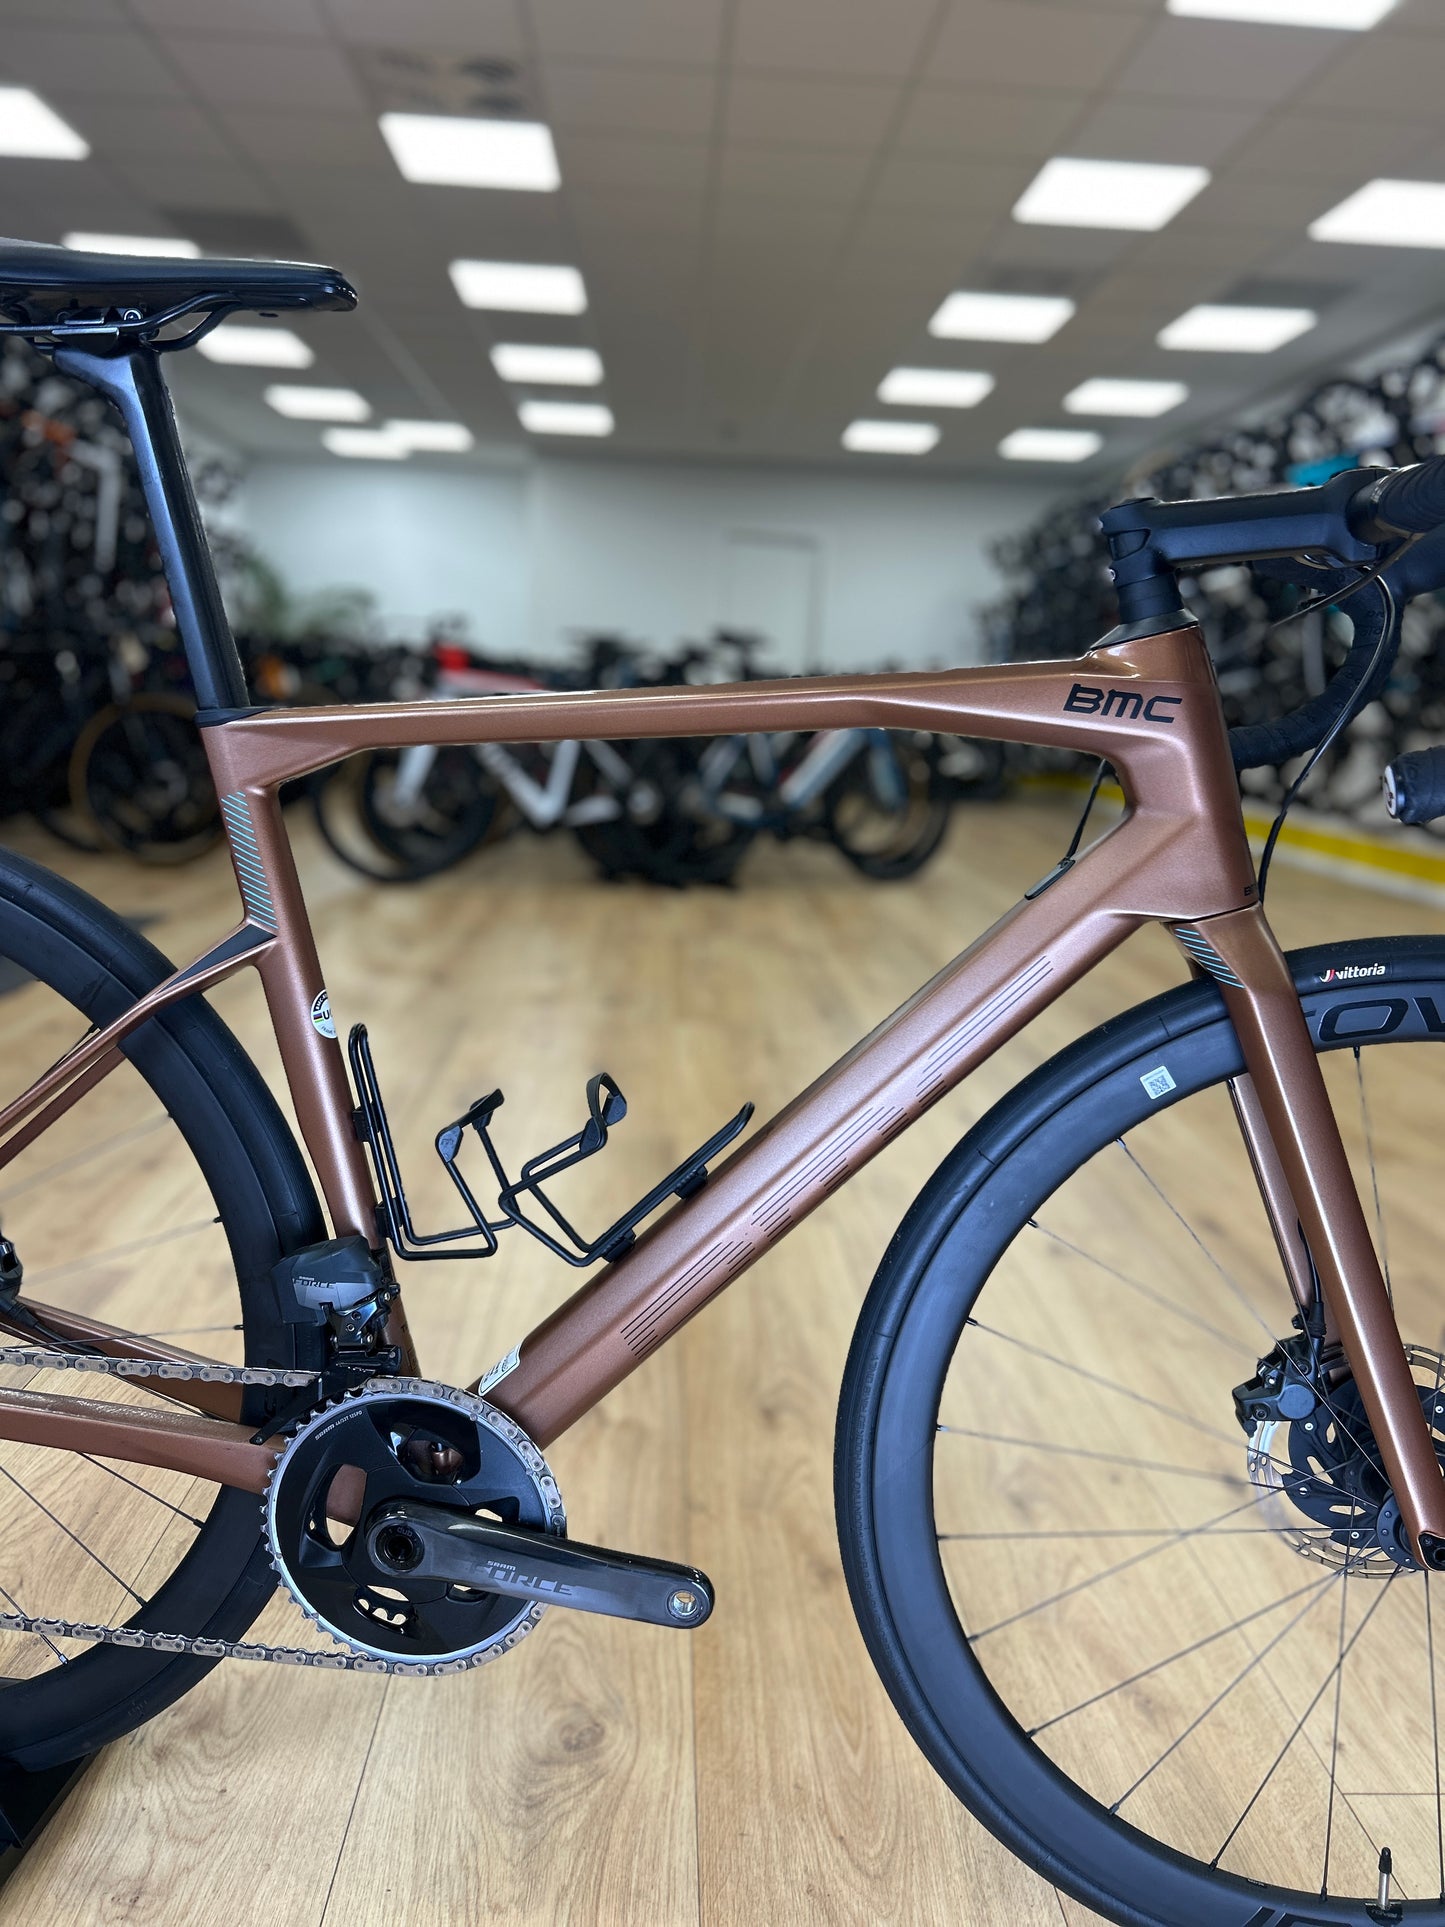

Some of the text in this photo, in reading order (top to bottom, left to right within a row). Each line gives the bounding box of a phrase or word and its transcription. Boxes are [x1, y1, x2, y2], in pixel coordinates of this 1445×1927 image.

[1063, 683, 1183, 723] BMC
[1335, 963, 1386, 980] vittoria
[294, 1279, 335, 1290] FORCE
[487, 1560, 516, 1571] SRAM
[470, 1562, 573, 1596] FORCE
